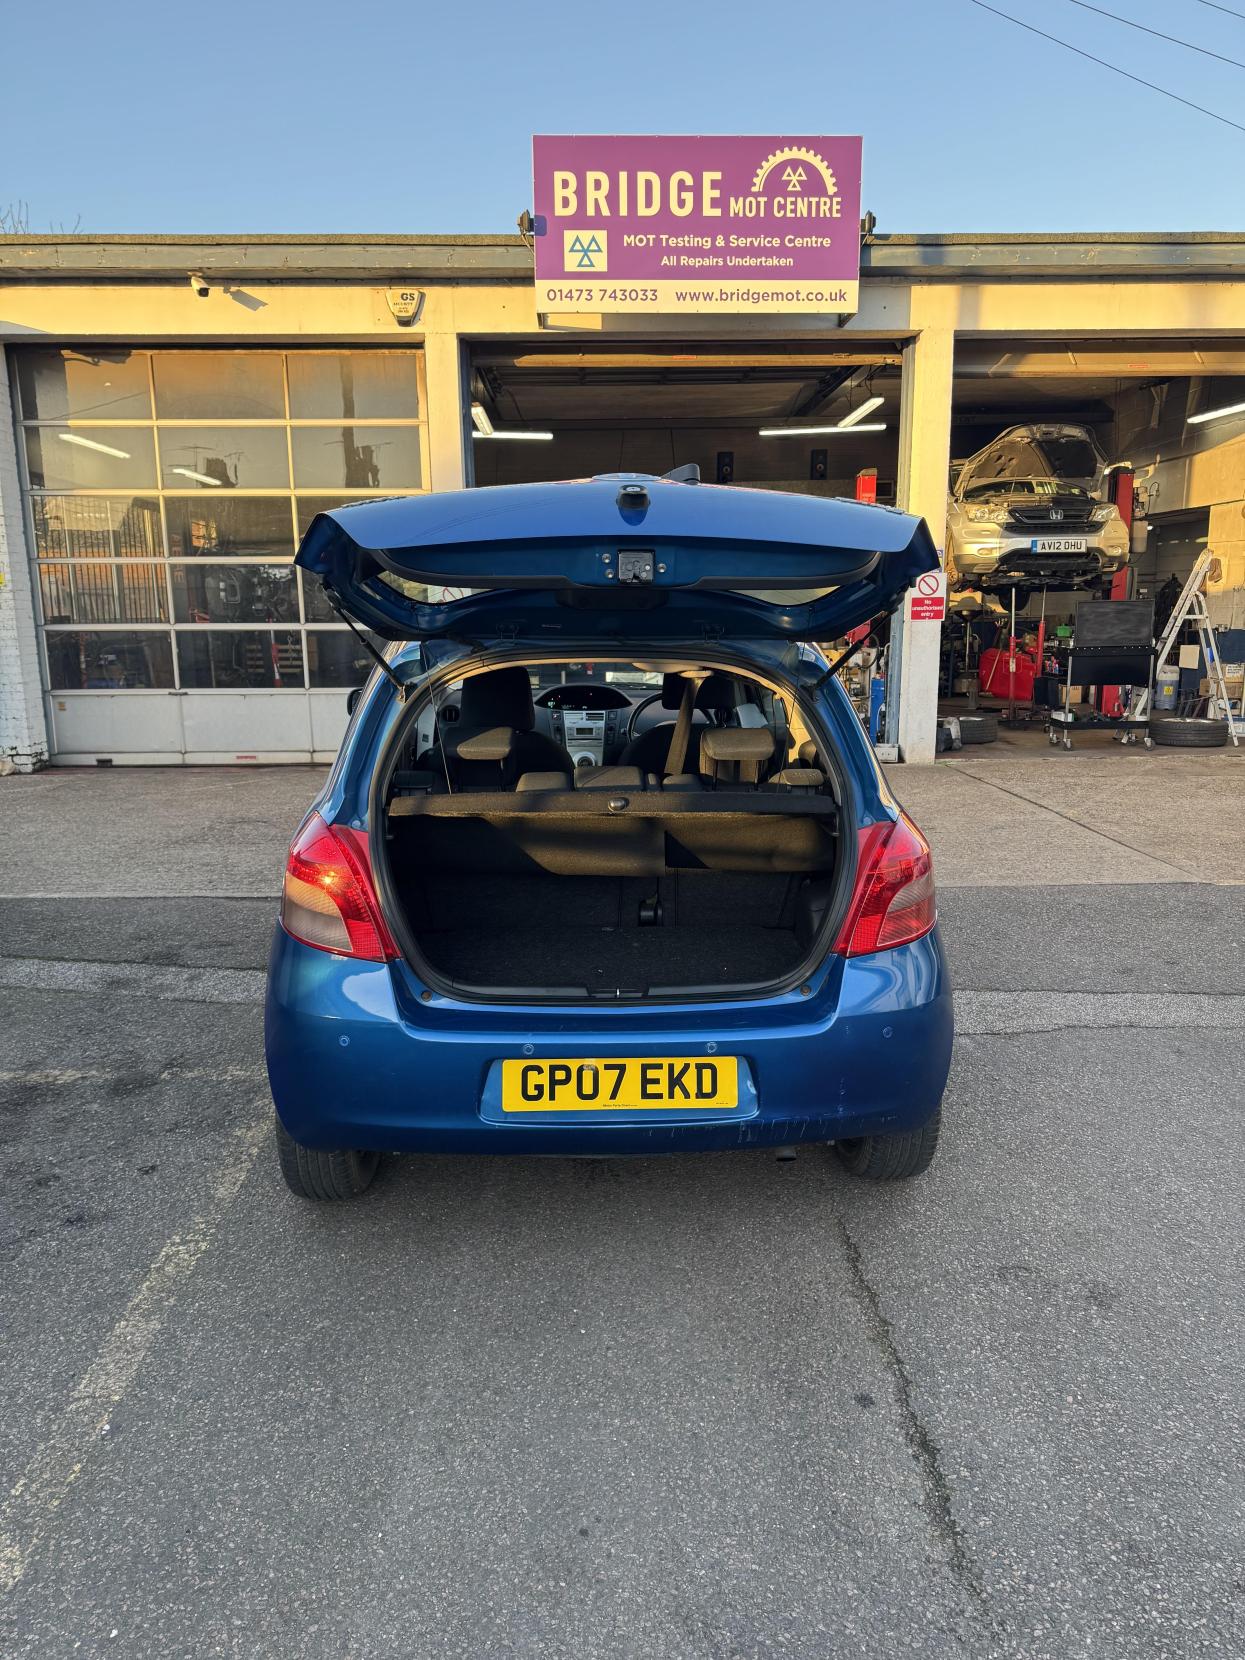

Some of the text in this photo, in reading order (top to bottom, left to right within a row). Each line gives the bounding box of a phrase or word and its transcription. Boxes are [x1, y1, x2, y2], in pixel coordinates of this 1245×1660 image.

[553, 170, 722, 217] BRIDGE
[729, 196, 842, 218] MOT CENTRE
[623, 234, 832, 250] MOT Testing & Service Centre
[660, 255, 794, 268] All Repairs Undertaken
[546, 288, 658, 302] 01473 743033
[675, 288, 848, 304] www.bridgemot.co.uk
[1040, 541, 1062, 551] AV12
[521, 1062, 718, 1102] GP07 EKD
